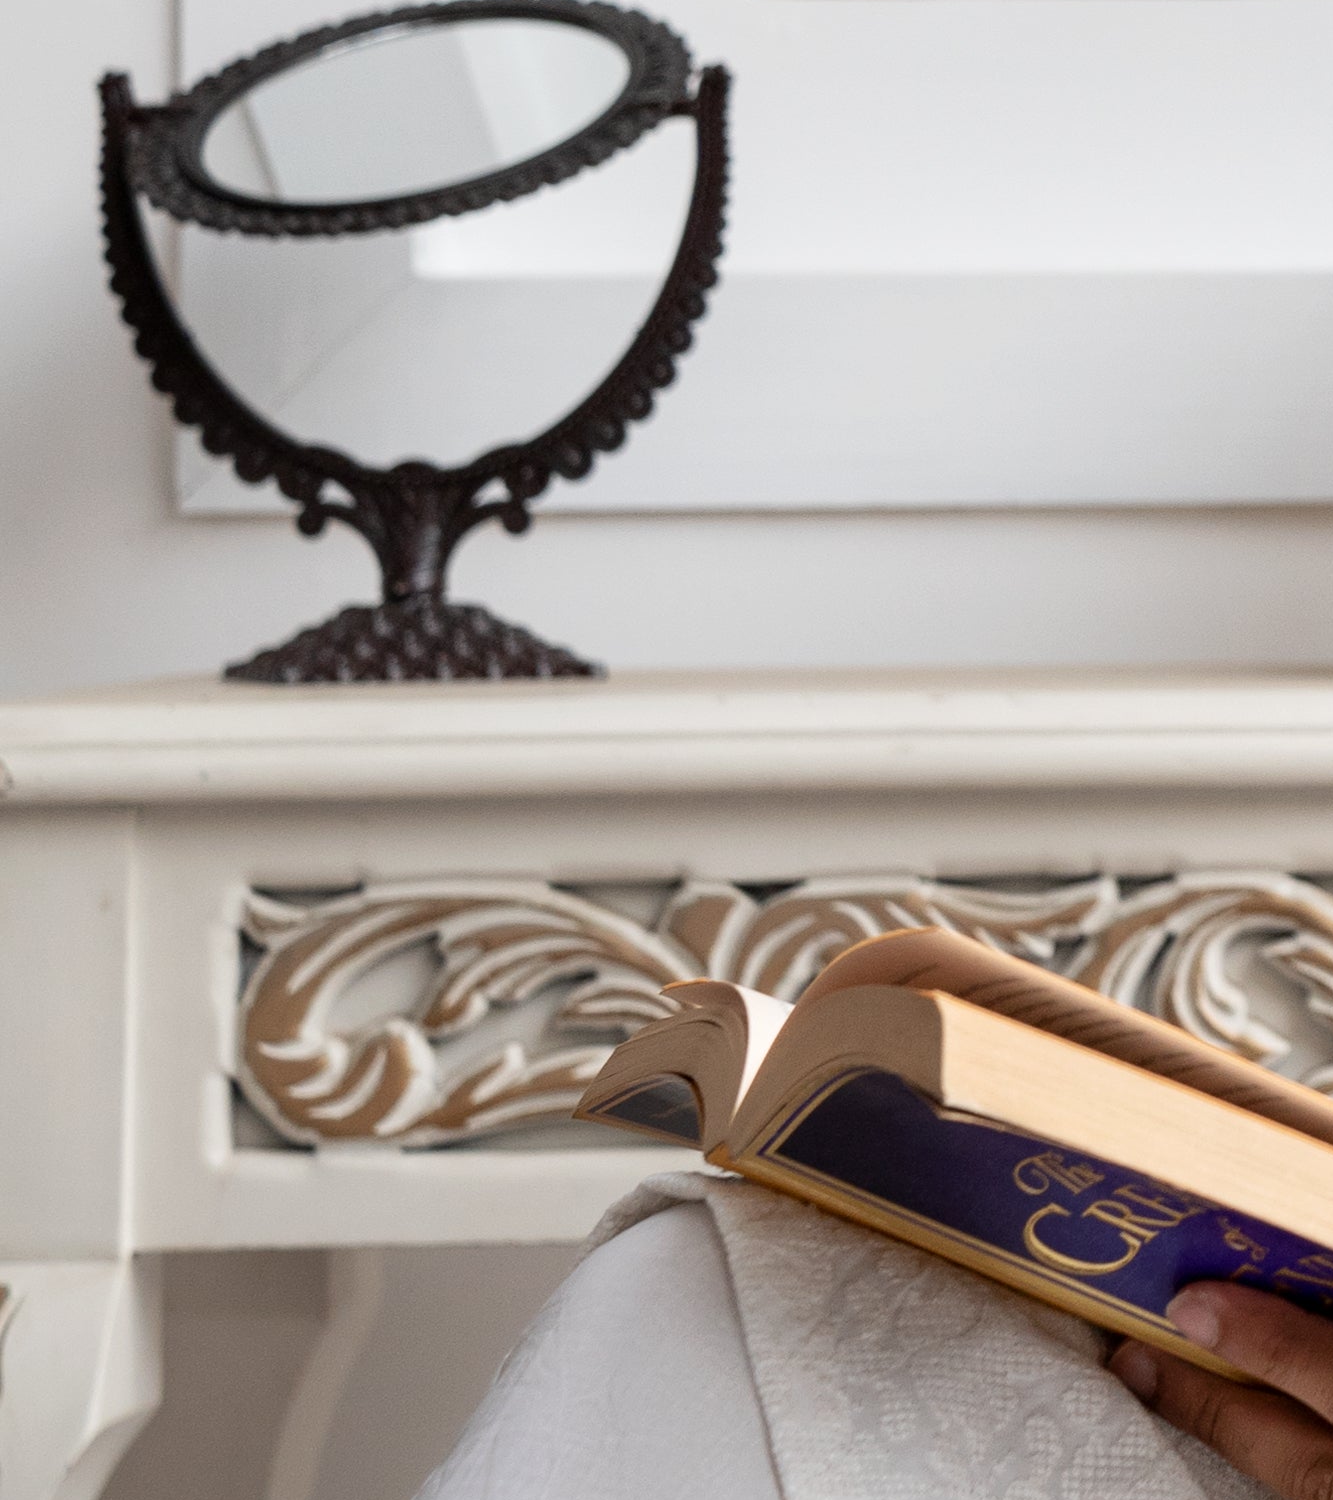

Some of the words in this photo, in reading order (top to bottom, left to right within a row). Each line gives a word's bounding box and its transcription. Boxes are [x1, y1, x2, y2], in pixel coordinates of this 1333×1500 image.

[1013, 1152, 1105, 1196] The
[1023, 1184, 1212, 1276] CRE
[1217, 1215, 1269, 1261] of
